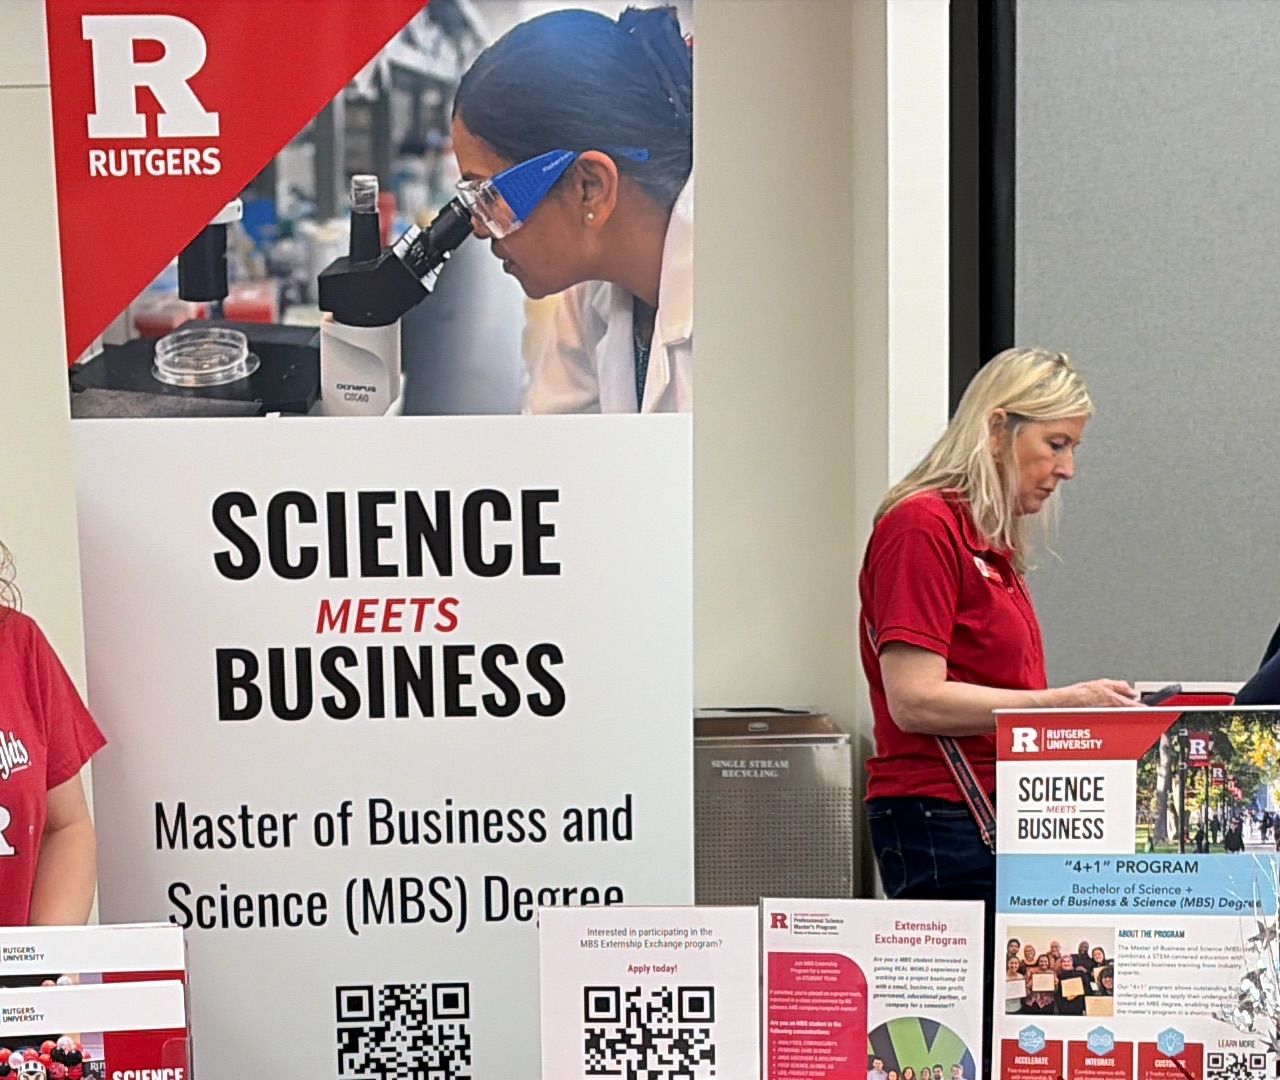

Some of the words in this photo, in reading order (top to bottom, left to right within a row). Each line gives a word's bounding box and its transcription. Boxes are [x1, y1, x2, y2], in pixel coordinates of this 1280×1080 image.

[82, 15, 220, 138] R
[89, 147, 221, 176] RUTGERS
[212, 489, 561, 580] SCIENCE
[316, 597, 459, 634] MEETS
[216, 643, 566, 721] BUSINESS
[1012, 727, 1039, 752] R
[1046, 729, 1091, 739] RUTGERS
[1046, 739, 1103, 750] UNIVERSITY
[1189, 739, 1207, 755] R
[711, 760, 746, 768] SINGLE
[749, 760, 789, 768] STREAM
[722, 770, 778, 778] RECYCLING
[1018, 776, 1105, 802] SCIENCE
[1046, 805, 1076, 814] MEETS
[155, 802, 297, 850] Master
[314, 800, 352, 846] of
[368, 798, 547, 845] Business
[562, 793, 633, 842] and
[1018, 818, 1104, 840] BUSINESS
[1116, 861, 1199, 873] PROGRAM
[1072, 883, 1121, 895] Bachelor
[1124, 883, 1136, 894] of
[1139, 884, 1181, 895] Science
[167, 882, 328, 929] Science
[345, 875, 468, 936] (MBS)
[484, 875, 624, 926] Degree
[1010, 896, 1049, 906] Master
[1052, 896, 1065, 906] of
[1068, 896, 1116, 907] Business
[1121, 897, 1129, 907] &
[1133, 897, 1177, 908] Science
[1180, 897, 1214, 909] (MBS)
[770, 913, 788, 929] R
[895, 921, 947, 934] Externship
[587, 928, 627, 936] Interested
[629, 928, 636, 936] in
[639, 928, 688, 938] participating
[691, 928, 698, 936] in
[700, 928, 712, 936] the
[1119, 930, 1139, 938] ABOUT
[1141, 930, 1152, 938] THE
[1154, 930, 1185, 938] PROGRAM
[580, 940, 598, 948] MBS
[601, 940, 642, 949] Externship
[644, 940, 683, 950] Exchange
[684, 939, 722, 950] program?
[875, 934, 922, 946] Exchange
[925, 935, 967, 947] Program
[628, 964, 650, 974] Apply
[653, 964, 678, 974] today!
[1218, 1040, 1237, 1048] LEARN
[1239, 1040, 1255, 1048] MORE
[1014, 1057, 1049, 1066] ACCELERATE
[1085, 1058, 1115, 1067] INTEGRATE
